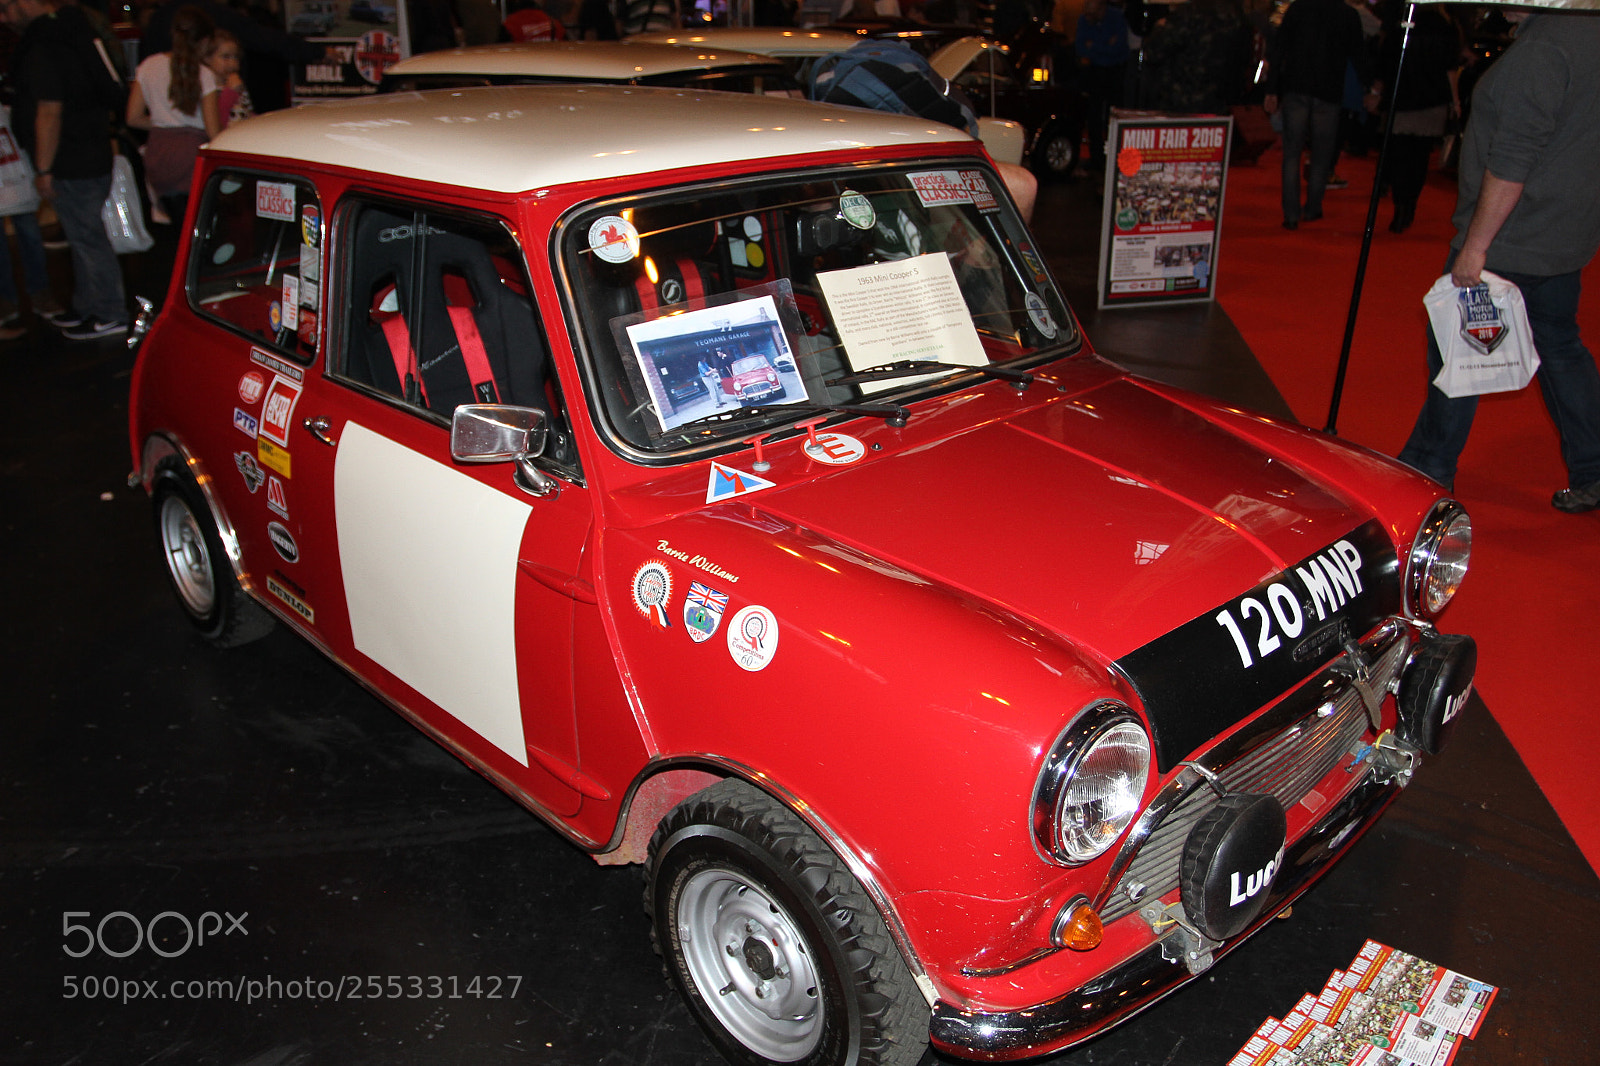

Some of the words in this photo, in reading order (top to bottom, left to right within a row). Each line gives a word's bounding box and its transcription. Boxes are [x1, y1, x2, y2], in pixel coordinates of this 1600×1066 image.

[306, 64, 343, 82] HALL
[1122, 128, 1156, 150] MINI
[1158, 128, 1189, 149] FAIR
[1191, 127, 1224, 148] 2016
[912, 173, 948, 186] practical
[960, 171, 983, 180] CLASSIC
[918, 183, 969, 202] CLASSICS
[965, 179, 990, 193] CAR
[258, 195, 293, 215] CLASSICS
[857, 276, 873, 286] 1963
[873, 273, 889, 283] Mini
[889, 269, 914, 280] Cooper
[1469, 305, 1493, 314] MOTOR
[1471, 313, 1494, 321] SHOW
[694, 334, 727, 347] YEOMANS
[728, 331, 751, 341] GARAGE
[1478, 329, 1493, 339] 2016
[236, 411, 256, 433] PTR
[816, 437, 856, 459] E
[656, 539, 689, 562] Barrie
[689, 554, 740, 583] Williams
[269, 581, 312, 618] DUNLOP
[1215, 582, 1303, 669] 120
[1295, 539, 1363, 622] MNP
[689, 627, 705, 640] BRDC
[732, 641, 764, 660] Competitions
[740, 654, 753, 667] 60
[1359, 940, 1382, 961] 2016
[675, 953, 699, 996] DUNLOP
[1349, 956, 1372, 975] FAIR
[1317, 987, 1341, 1007] FAIR
[1281, 1011, 1308, 1031] FAIR
[1243, 1035, 1269, 1057] FAIR
